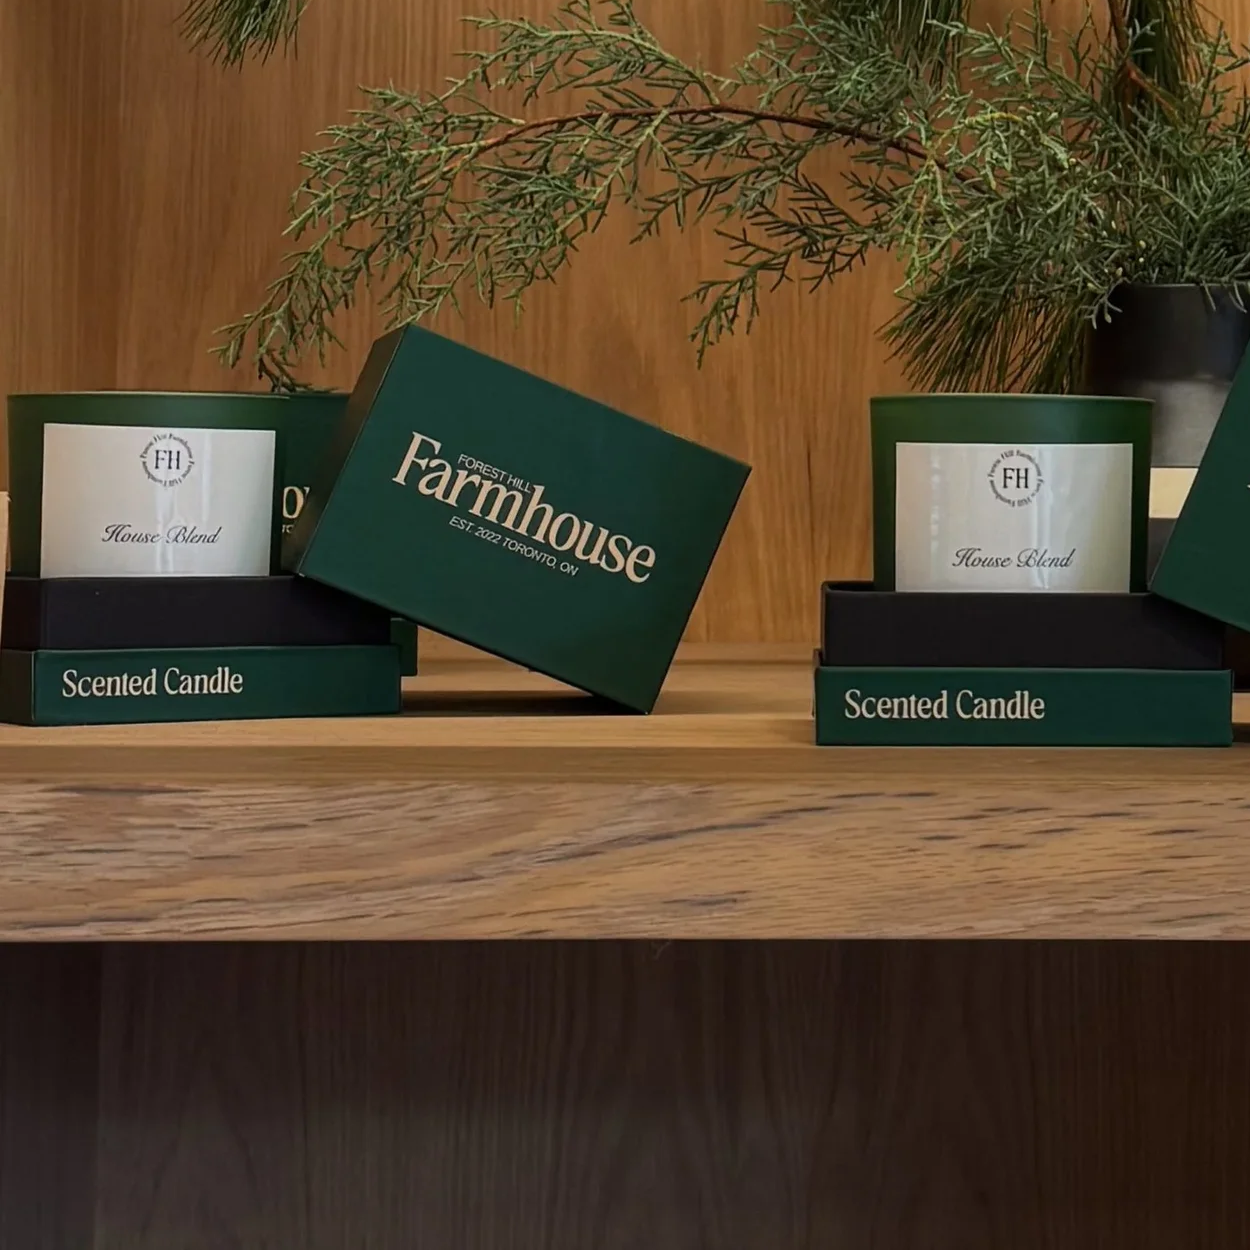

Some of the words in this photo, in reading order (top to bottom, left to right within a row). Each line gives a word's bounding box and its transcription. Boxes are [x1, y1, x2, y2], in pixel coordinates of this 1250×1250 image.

[154, 449, 181, 470] FH
[457, 453, 507, 483] FOREST
[507, 474, 532, 494] HILL
[1003, 467, 1029, 489] FH
[391, 431, 657, 584] Farmhouse
[101, 523, 161, 543] House
[165, 524, 223, 544] Blend
[449, 515, 474, 534] EST.
[475, 525, 501, 544] 2022
[502, 537, 556, 569] TORONTO,
[560, 561, 579, 577] ON
[952, 547, 1012, 568] House
[1016, 547, 1077, 568] Blend
[62, 667, 157, 698] Scented
[163, 666, 244, 696] Candle
[844, 689, 949, 720] Scented
[955, 689, 1046, 720] Candle
